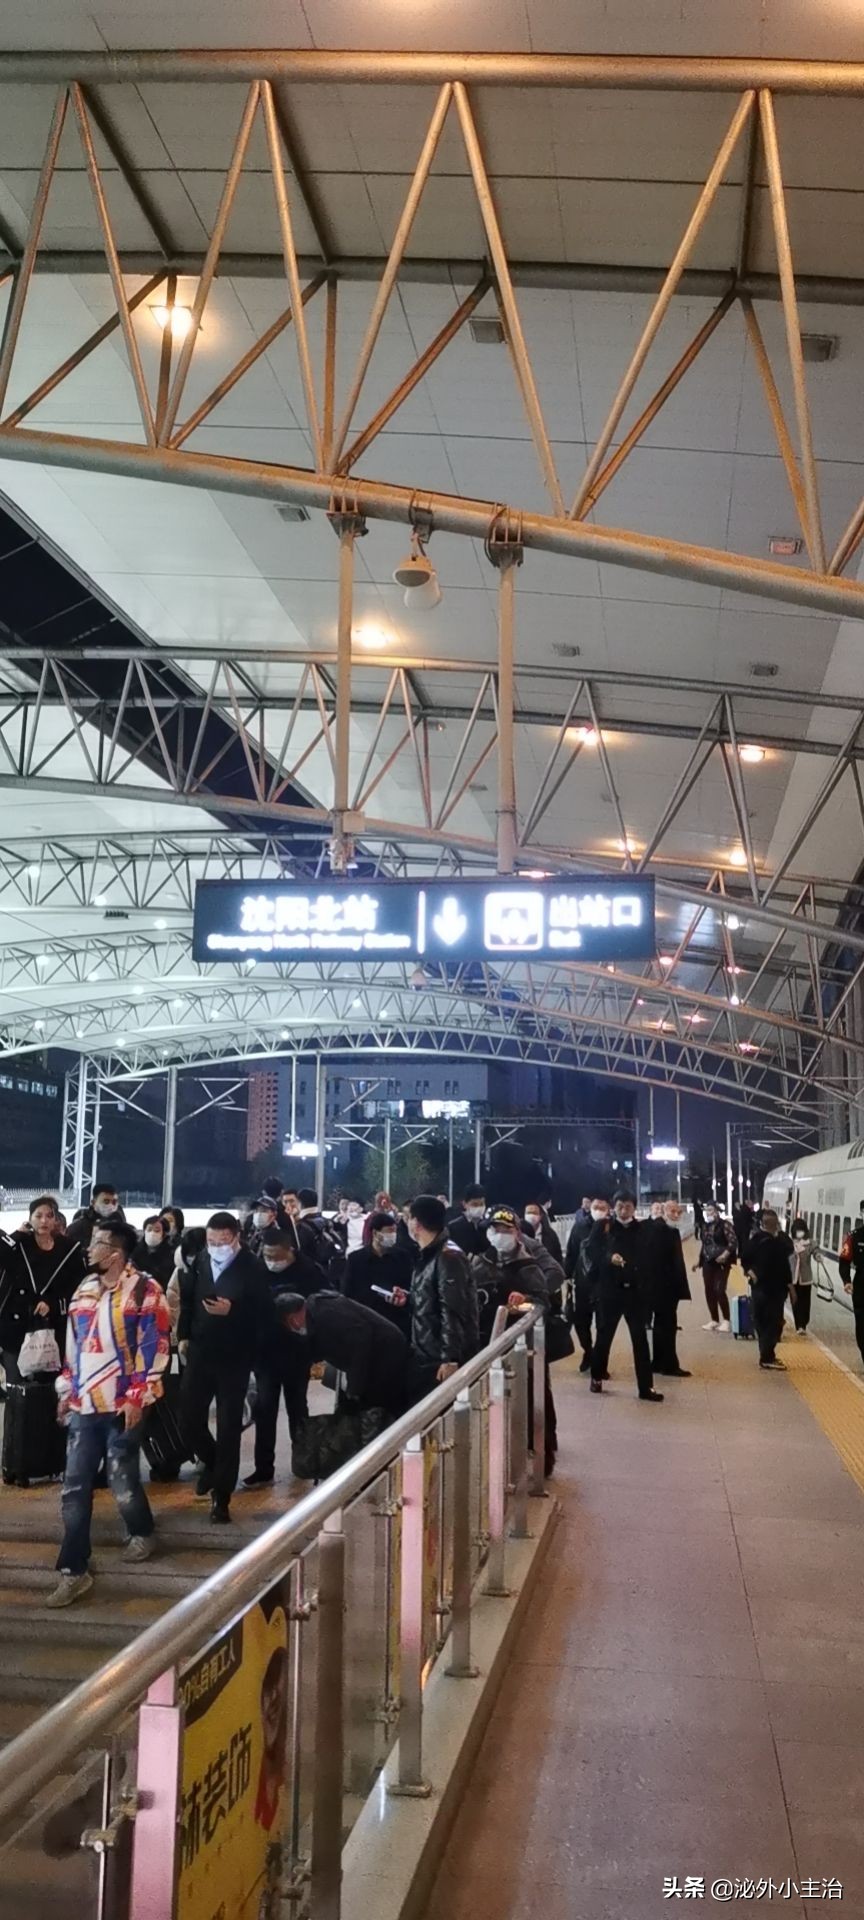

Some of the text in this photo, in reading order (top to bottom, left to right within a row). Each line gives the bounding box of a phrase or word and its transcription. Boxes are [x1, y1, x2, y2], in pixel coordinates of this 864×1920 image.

[240, 895, 379, 932] 沈阳北站
[550, 894, 641, 928] 出站口
